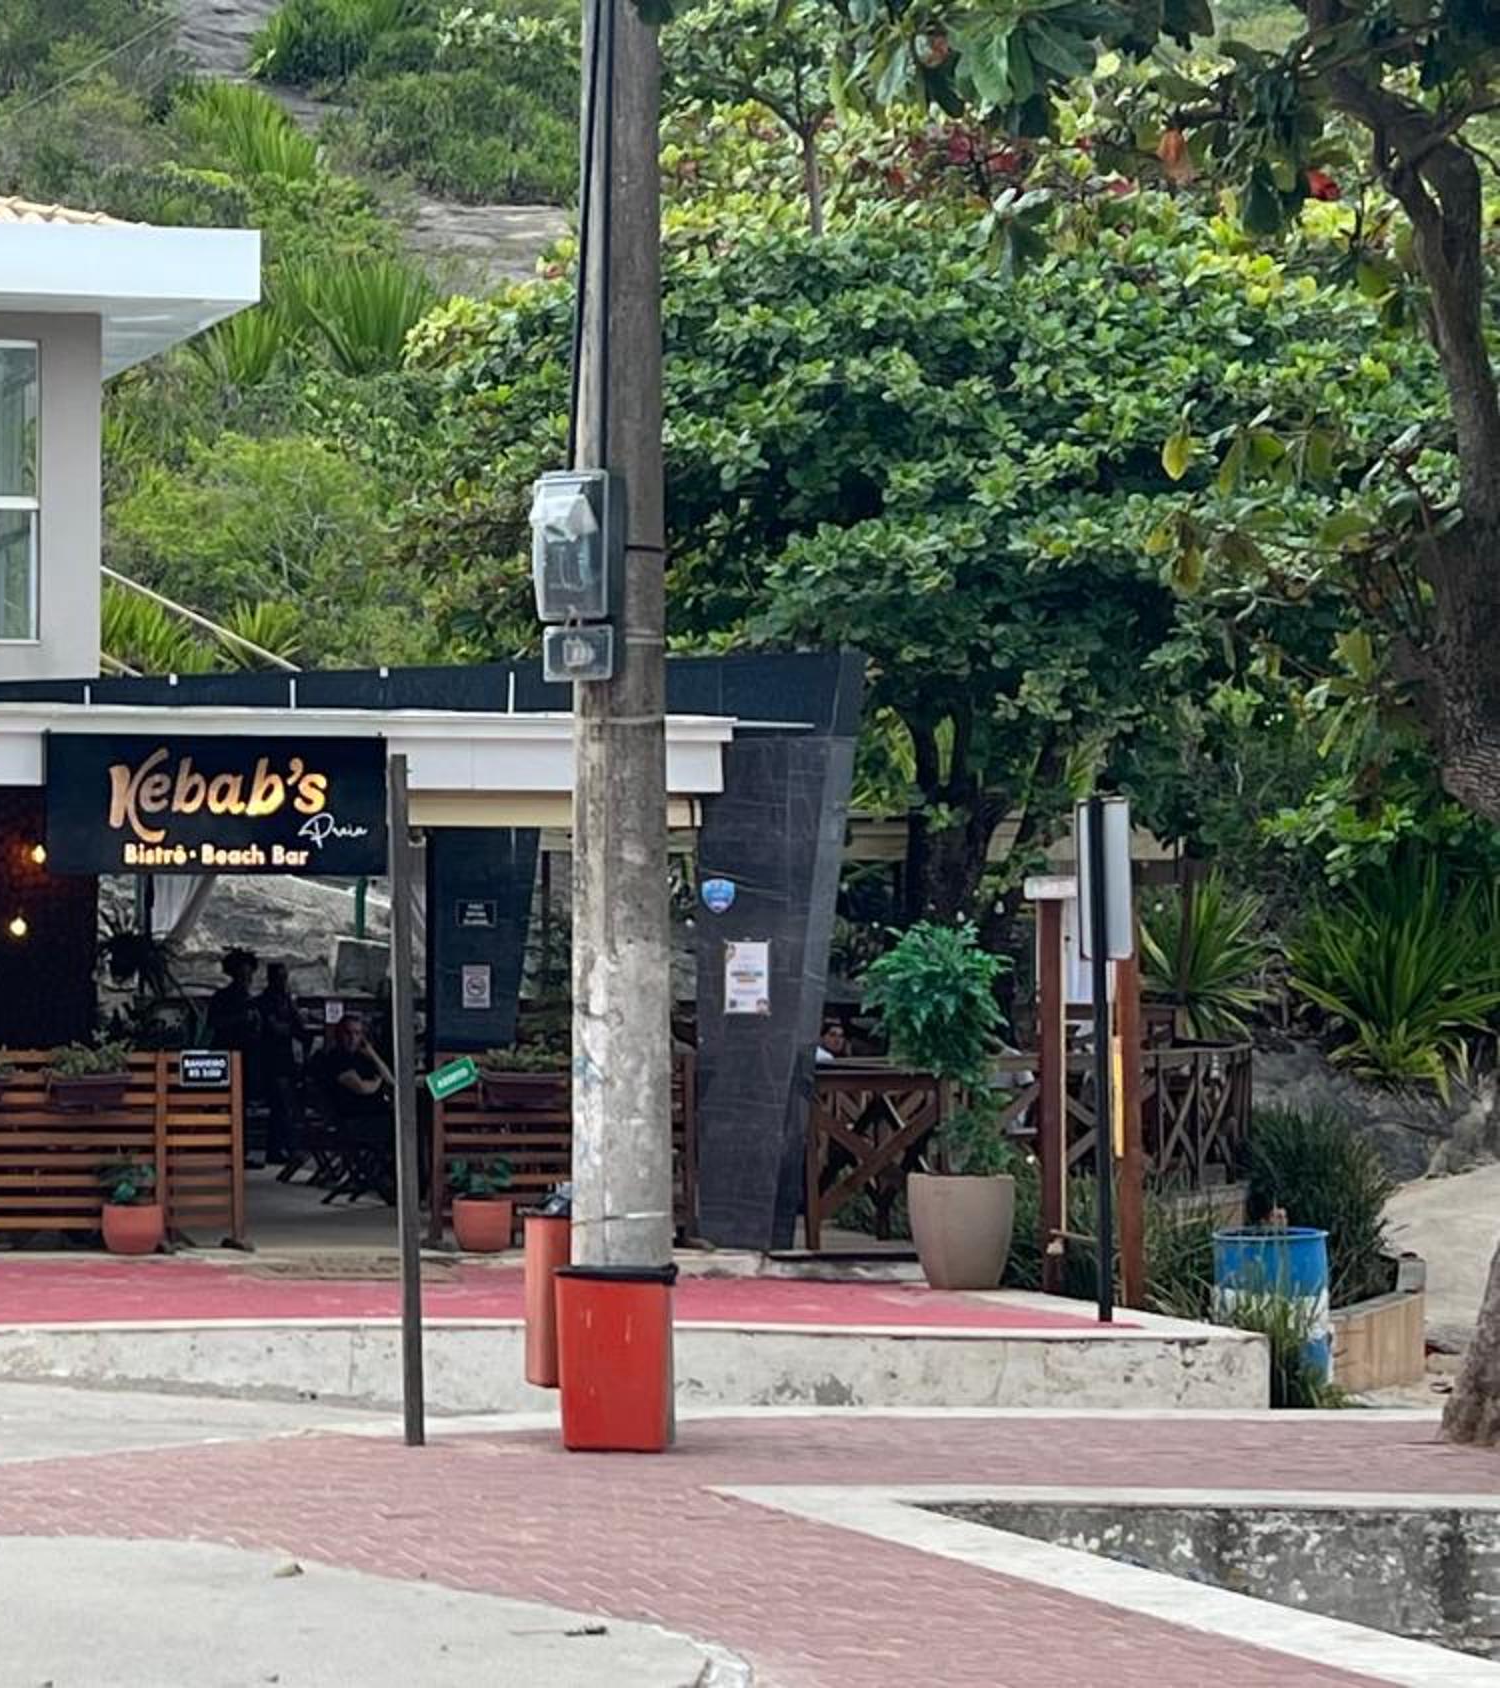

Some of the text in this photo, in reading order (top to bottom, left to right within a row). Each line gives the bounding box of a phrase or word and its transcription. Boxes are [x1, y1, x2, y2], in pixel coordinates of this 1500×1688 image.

[109, 748, 328, 842] Kebab's
[201, 843, 265, 865] Beach
[271, 846, 309, 865] Bar
